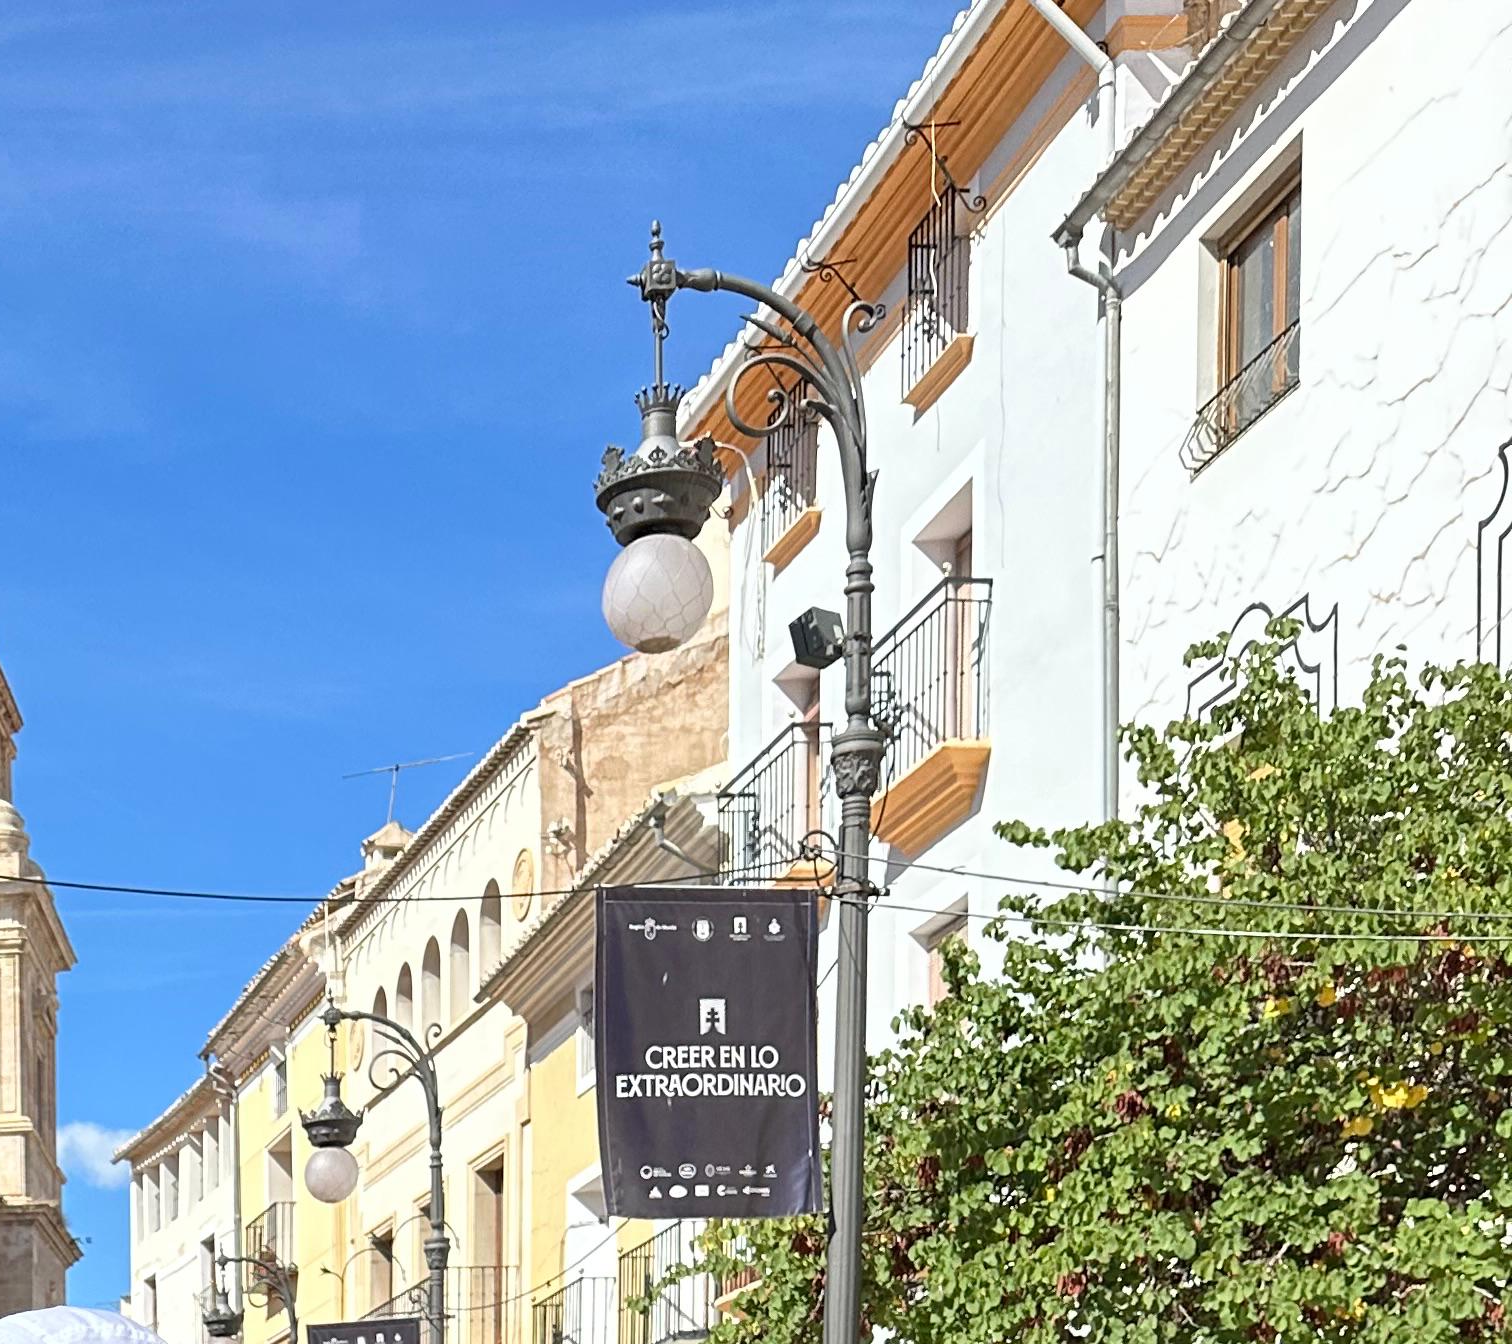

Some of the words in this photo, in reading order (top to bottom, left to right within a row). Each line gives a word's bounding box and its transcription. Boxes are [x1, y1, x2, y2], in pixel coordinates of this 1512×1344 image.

[645, 1045, 715, 1069] CREER
[720, 1046, 745, 1069] EN
[750, 1045, 779, 1069] LO
[616, 1073, 806, 1098] EXTRAORDINARIO
